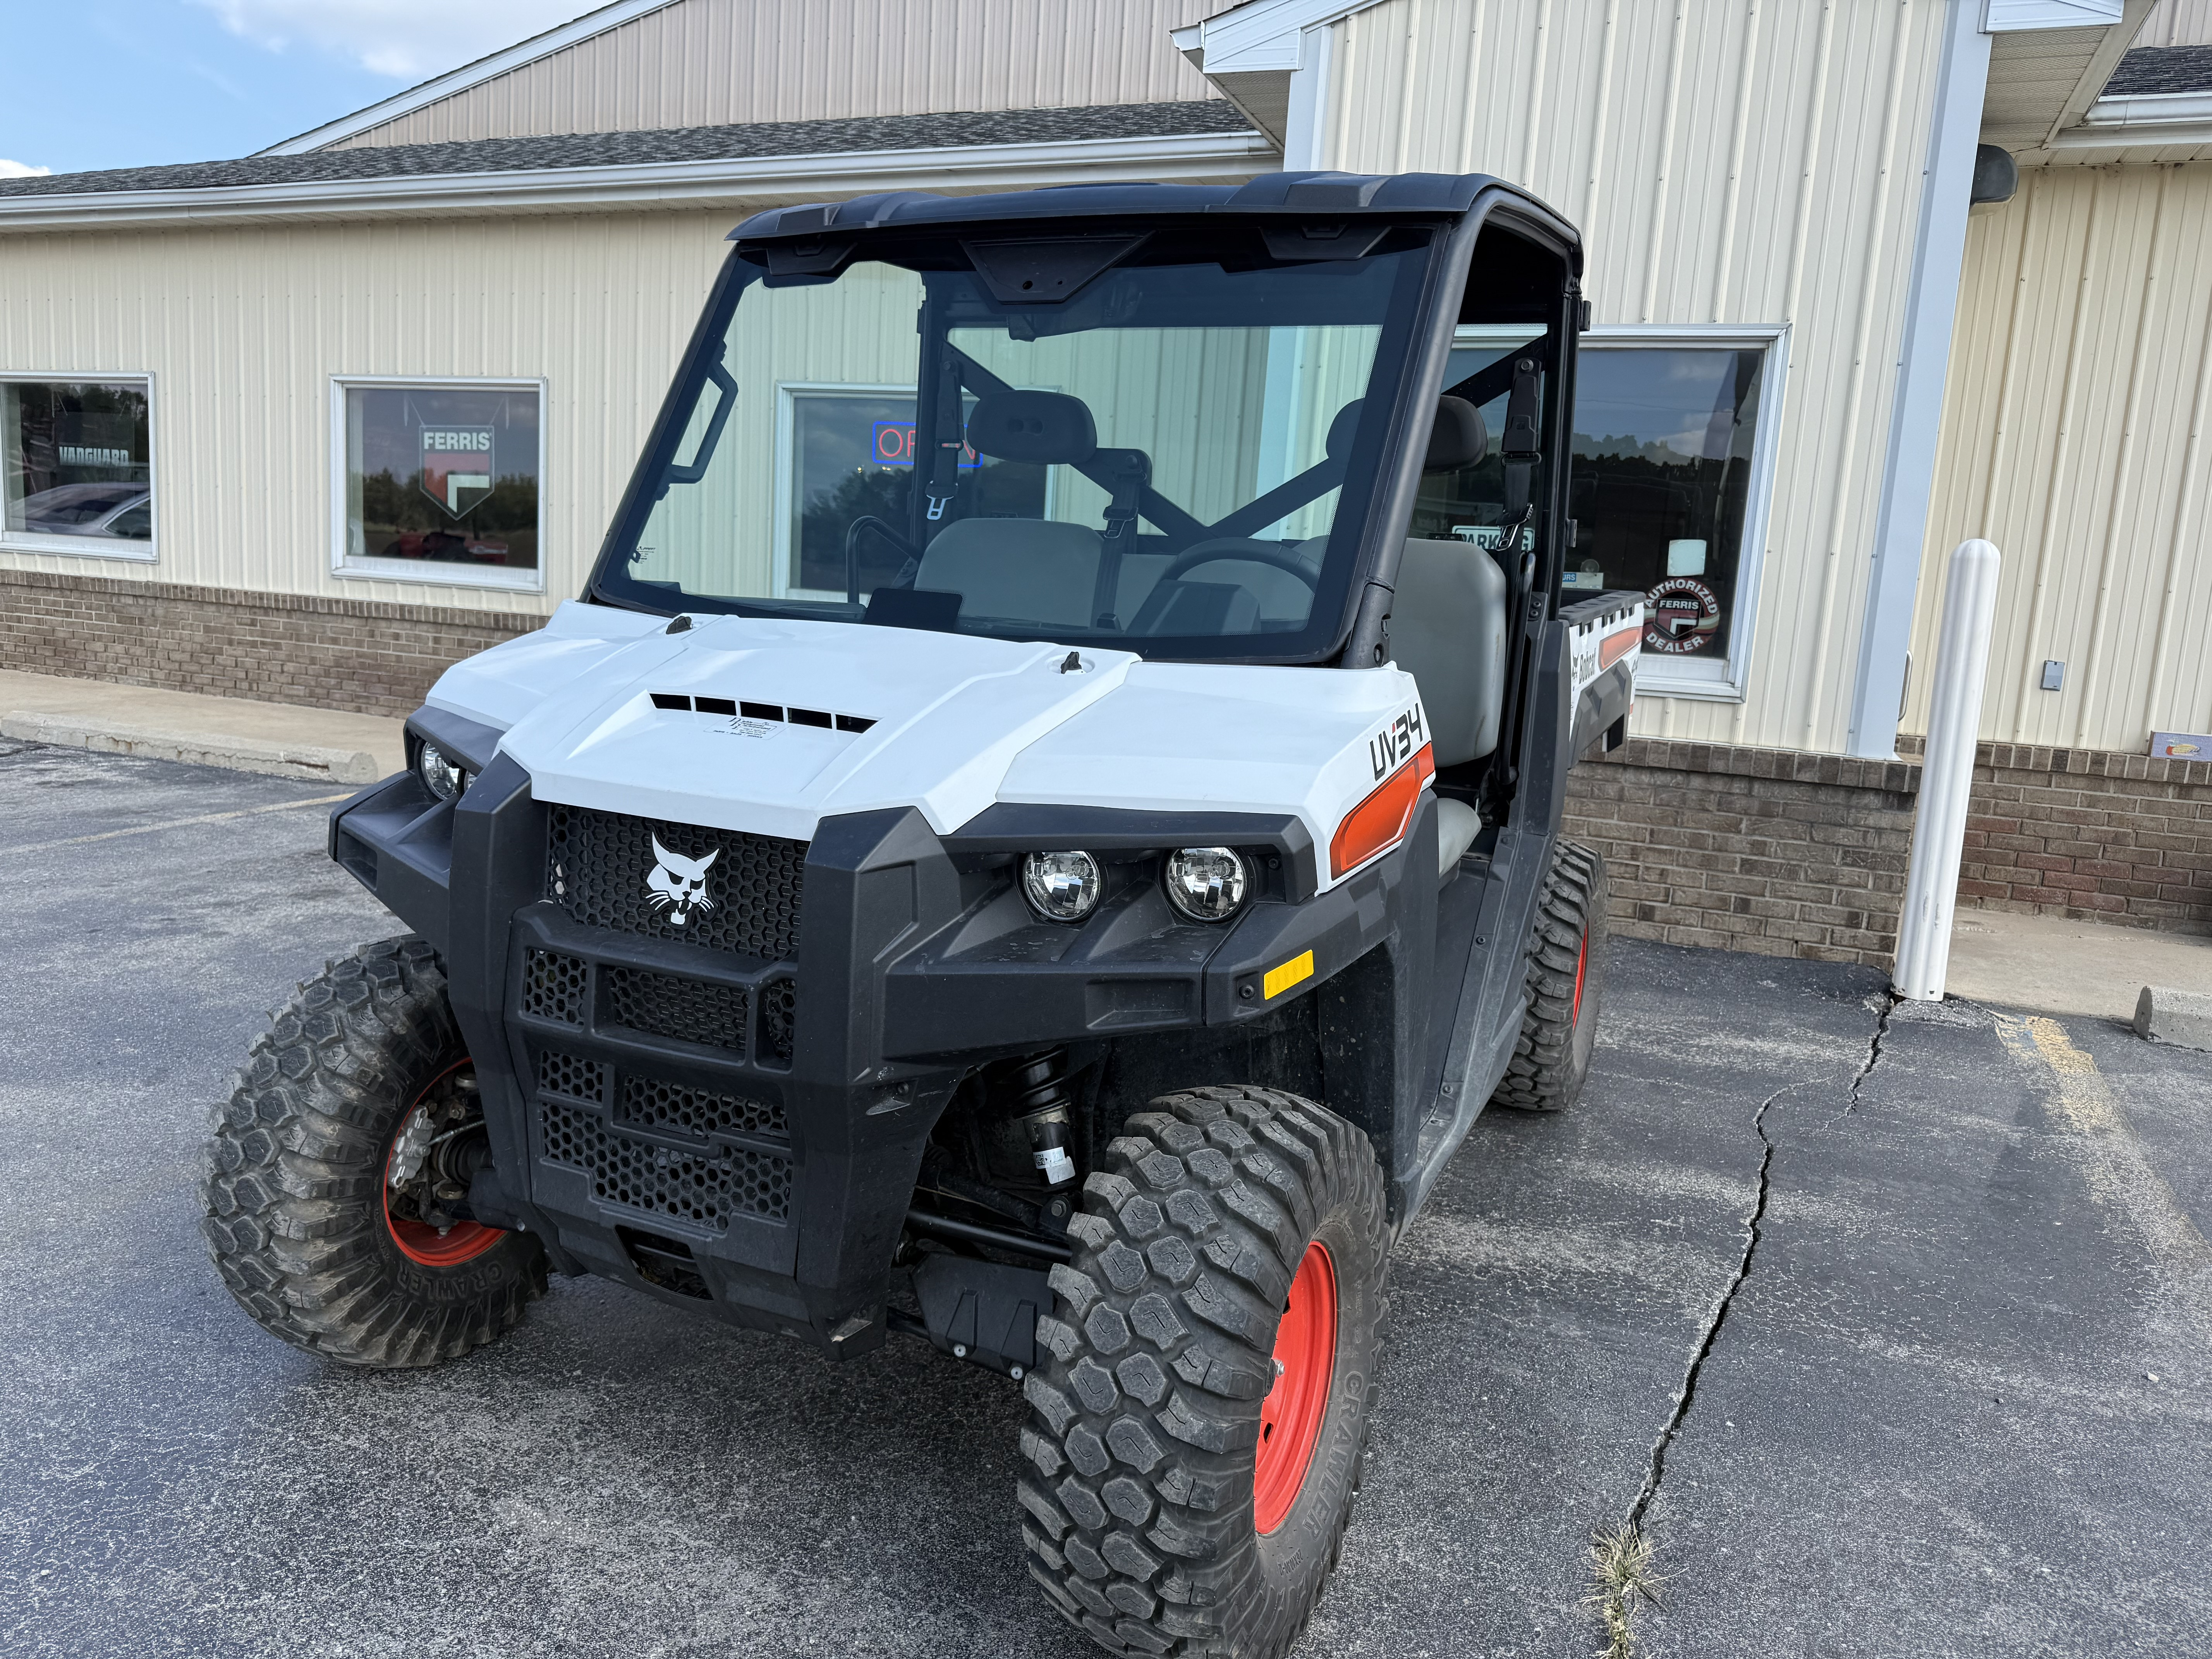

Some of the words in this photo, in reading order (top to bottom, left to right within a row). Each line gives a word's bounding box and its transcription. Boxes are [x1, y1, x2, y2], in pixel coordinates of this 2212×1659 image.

[59, 446, 129, 467] VANGUARD
[424, 432, 490, 450] FERRIS
[879, 429, 975, 460] OP
[1462, 534, 1529, 551] ARKG
[1645, 579, 1717, 614] AUTHORIZED
[1659, 600, 1699, 610] FERRIS
[1646, 632, 1704, 653] DEALER
[1579, 647, 1596, 684] Bobcat
[1370, 702, 1423, 781] UV34
[397, 1261, 503, 1300] CRAWLER
[1302, 1371, 1364, 1541] CRAWLER
